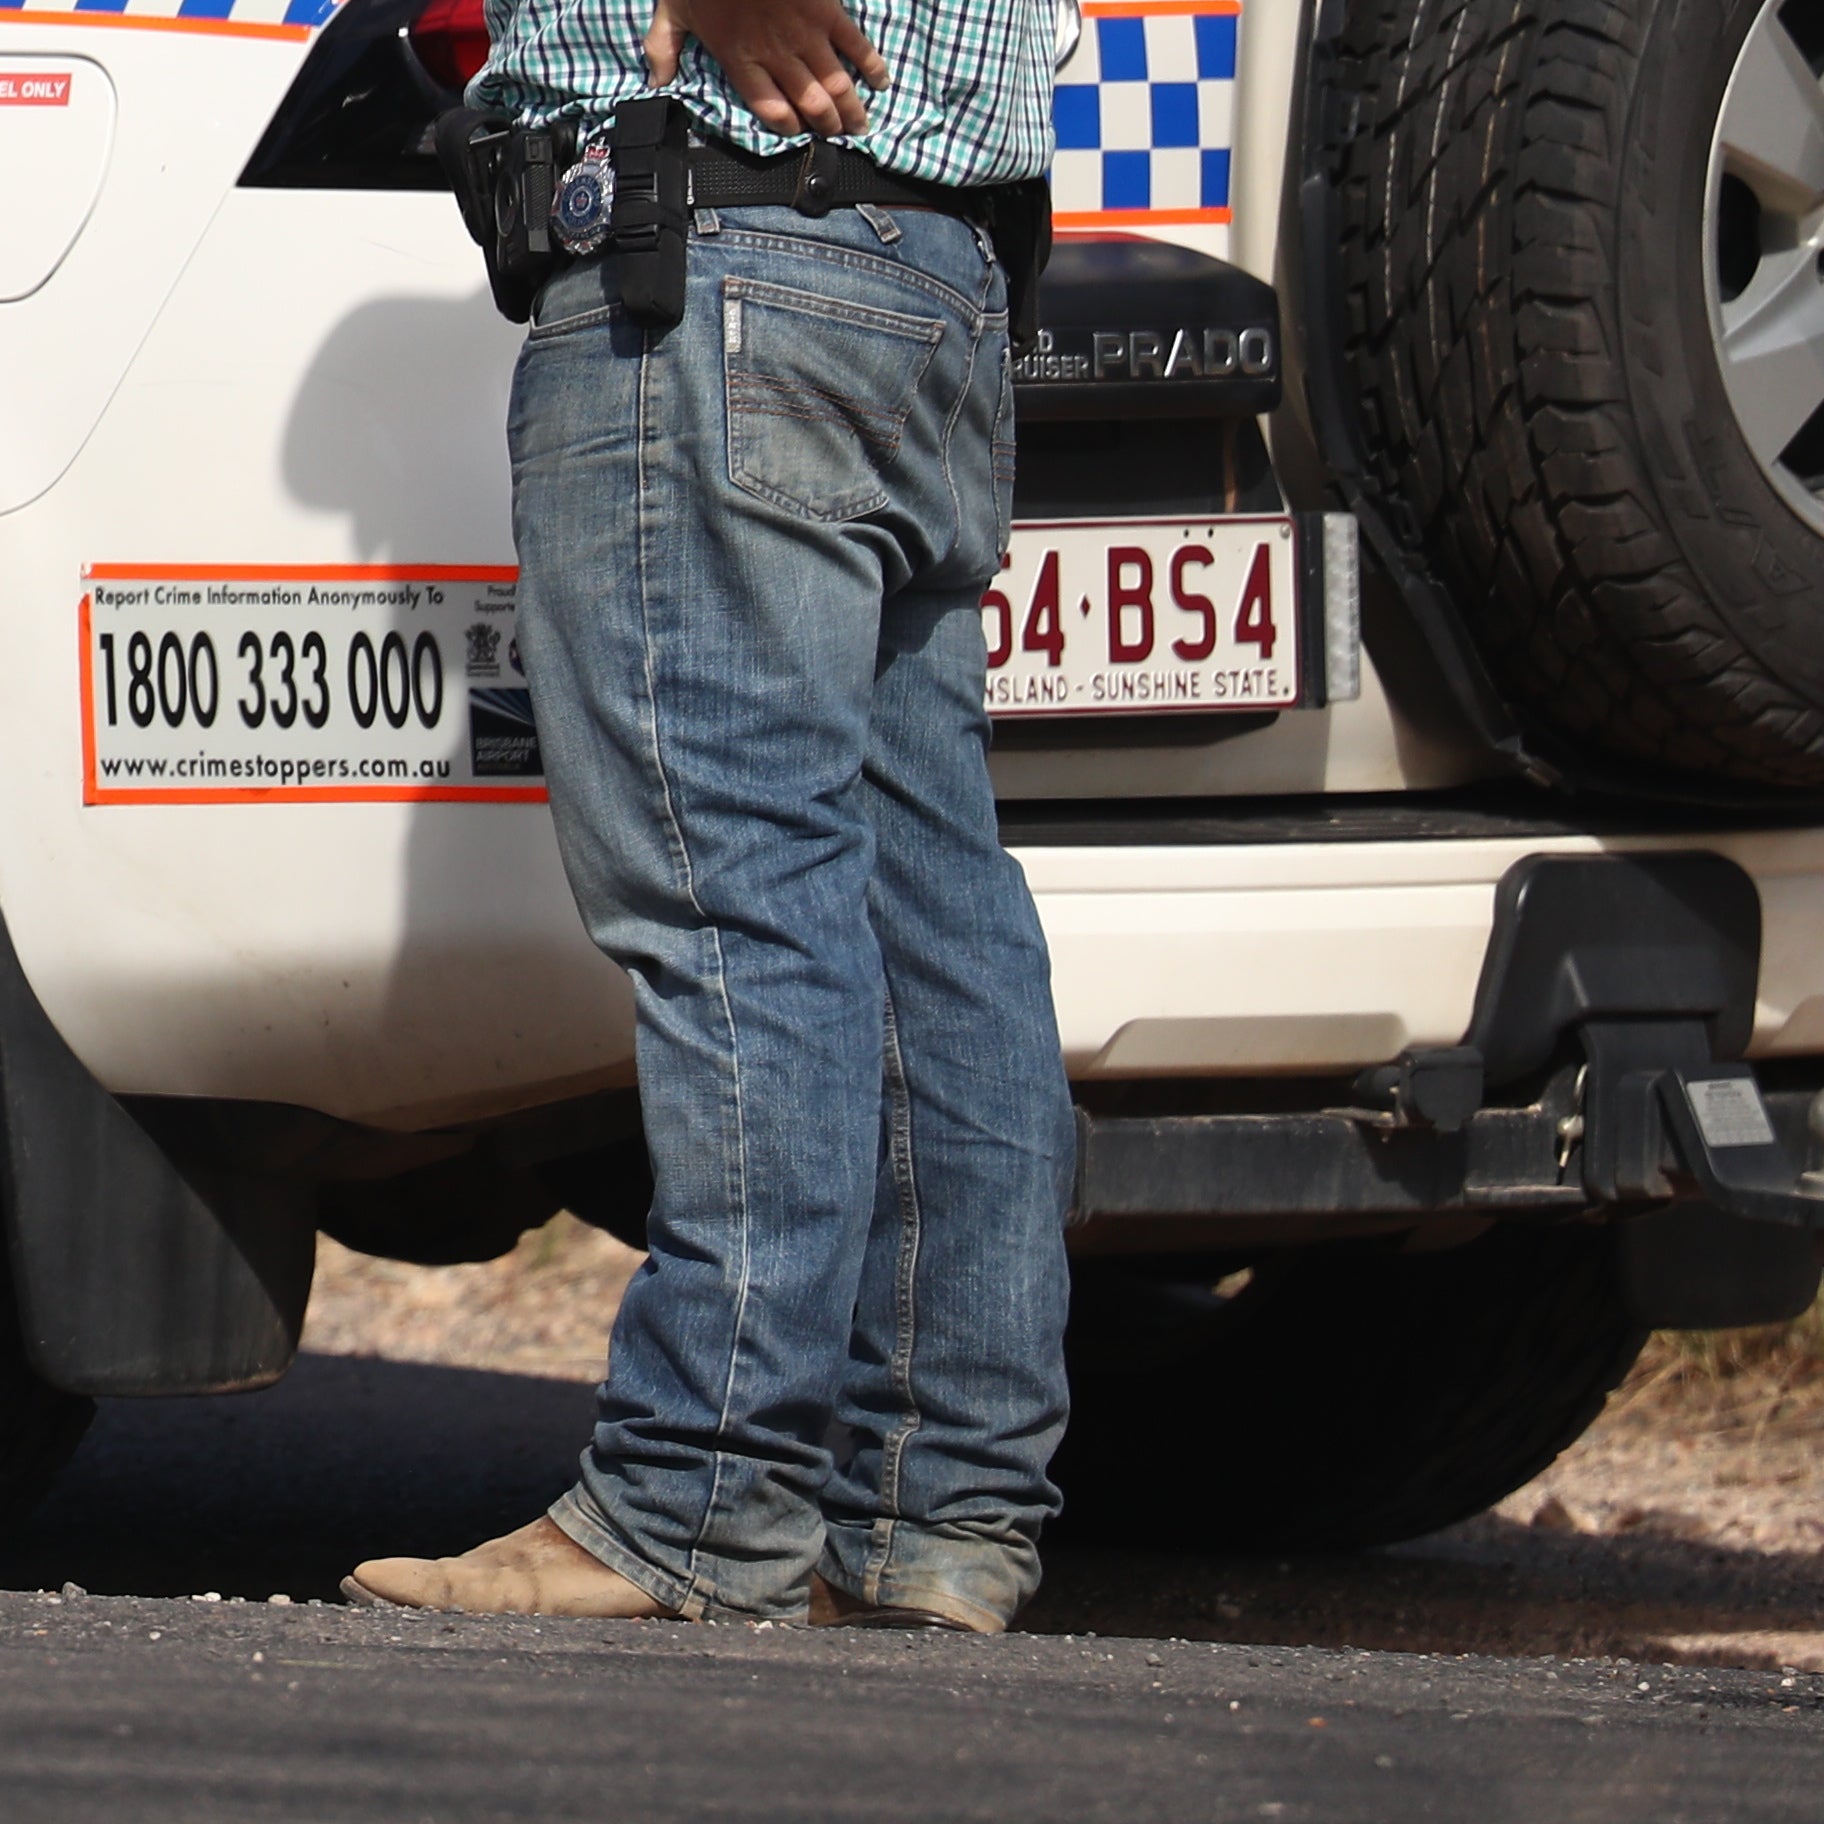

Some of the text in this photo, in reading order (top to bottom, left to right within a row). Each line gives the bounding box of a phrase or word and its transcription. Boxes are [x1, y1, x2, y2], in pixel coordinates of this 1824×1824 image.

[22, 81, 66, 99] ONLY
[1012, 355, 1089, 380] RUISER
[1093, 328, 1272, 378] PRADO
[95, 585, 443, 609] Report Crime Information Anonymously To
[487, 585, 516, 597] Proud
[474, 601, 515, 613] Supporte
[99, 630, 442, 729] 1800 333 000
[986, 675, 1067, 703] NSLAND
[1092, 673, 1201, 701] SUNSHINE
[1214, 670, 1277, 696] STATE
[100, 751, 450, 782] www.crimestoppers.com.au
